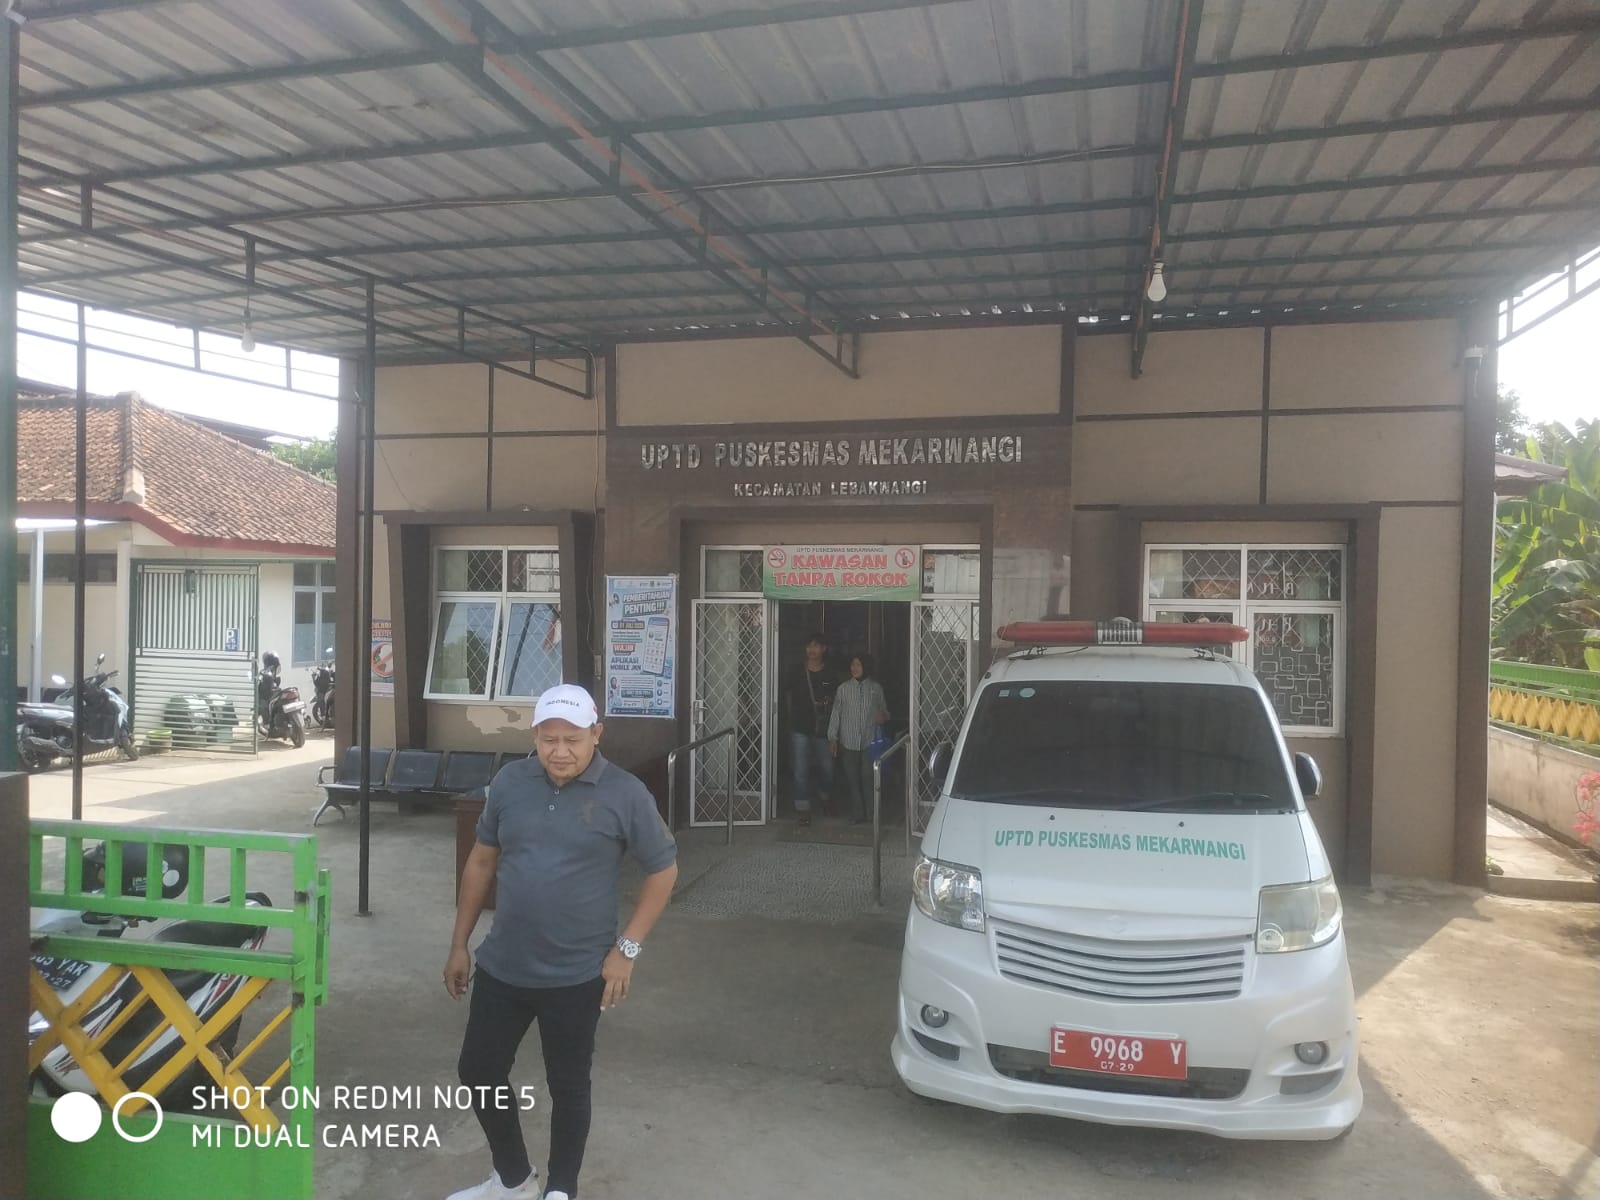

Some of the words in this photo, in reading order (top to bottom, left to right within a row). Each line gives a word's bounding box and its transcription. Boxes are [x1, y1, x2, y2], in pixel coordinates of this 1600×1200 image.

[641, 443, 701, 469] UPTD
[714, 440, 850, 468] PUSKESMAS
[857, 436, 1023, 465] MEKARWANGI
[734, 483, 822, 497] KECAMATAN
[831, 480, 928, 496] LEBAKWANGI
[791, 554, 888, 569] KAWASAN
[773, 571, 837, 587] TANPA
[841, 571, 909, 587] ROKOK
[994, 830, 1034, 847] UPTD
[1038, 830, 1131, 850] PUSKESMAS
[1136, 834, 1247, 860] MEKARWANGI
[1053, 1031, 1067, 1054] E
[1090, 1036, 1144, 1062] 9968
[1170, 1042, 1183, 1065] Y
